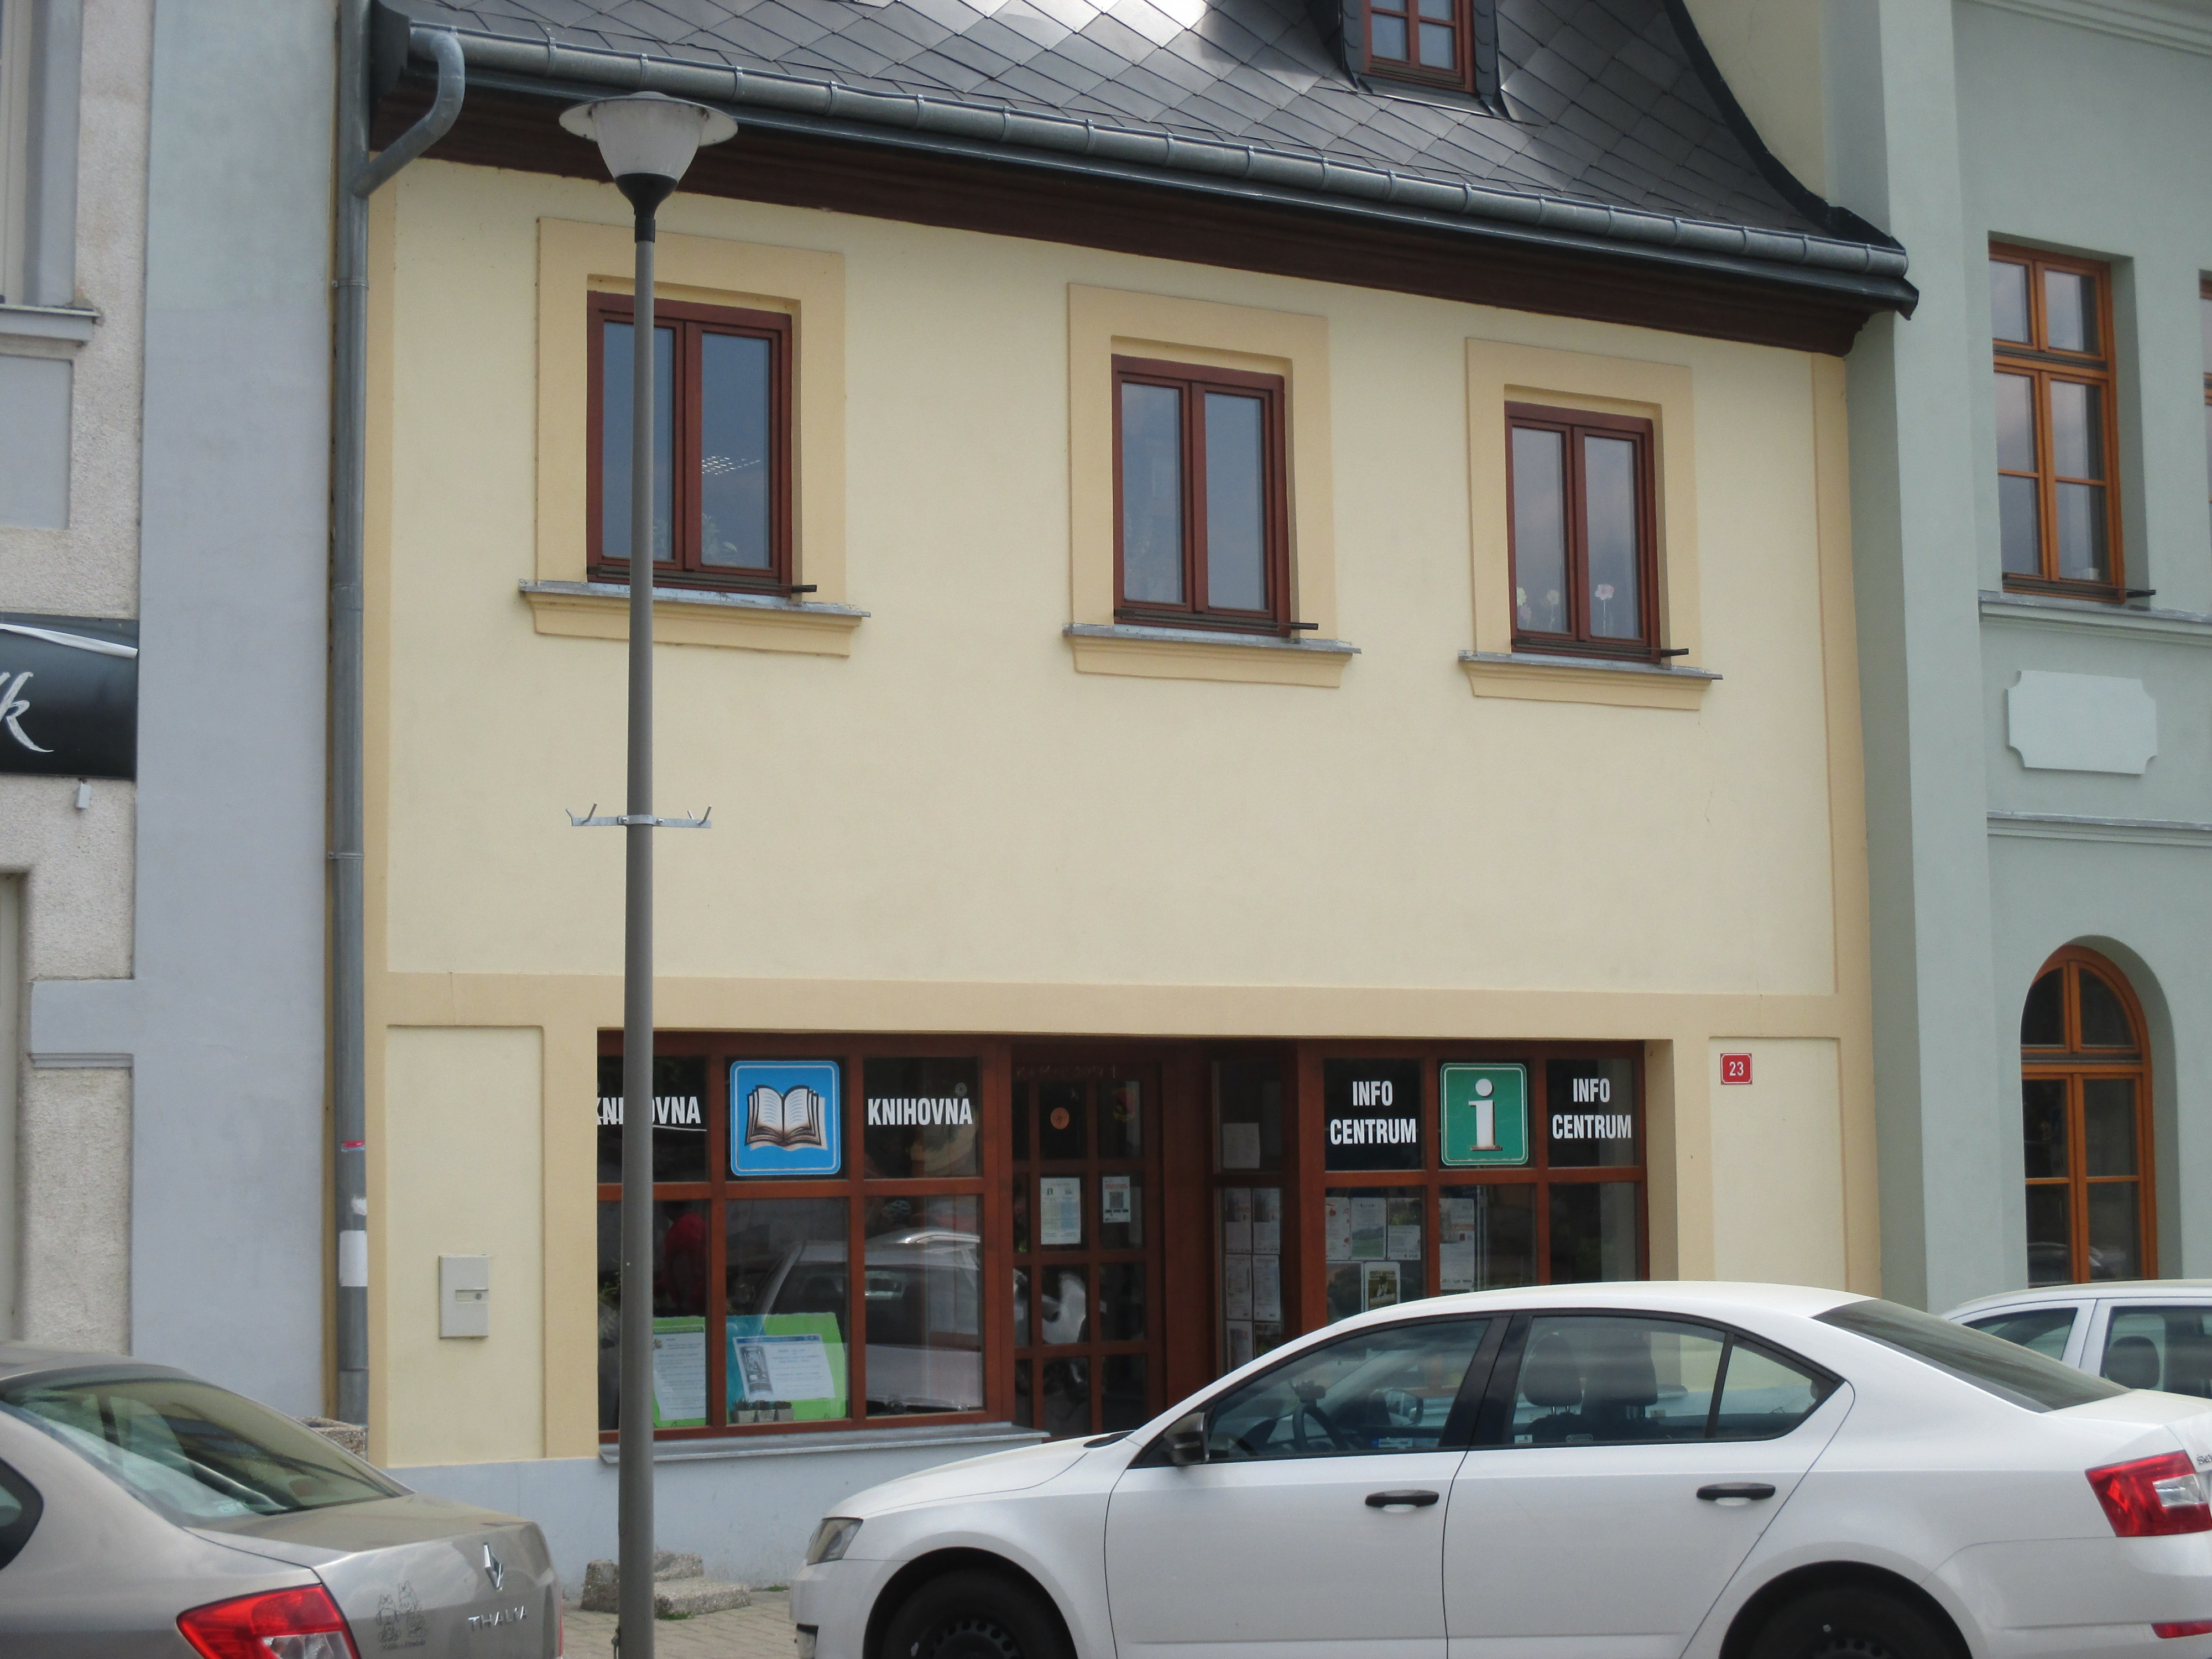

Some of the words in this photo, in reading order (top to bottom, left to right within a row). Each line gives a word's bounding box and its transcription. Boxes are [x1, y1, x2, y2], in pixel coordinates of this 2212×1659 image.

[1729, 1061, 1744, 1076] 23
[1353, 1081, 1393, 1106] INFO
[1573, 1078, 1610, 1102] INFO
[597, 1096, 701, 1125] NIVNA
[868, 1098, 973, 1125] KNIHOVNA
[1330, 1118, 1416, 1145] CENTRUM
[1552, 1114, 1631, 1139] CENTRUM
[468, 1605, 528, 1632] THALIA
